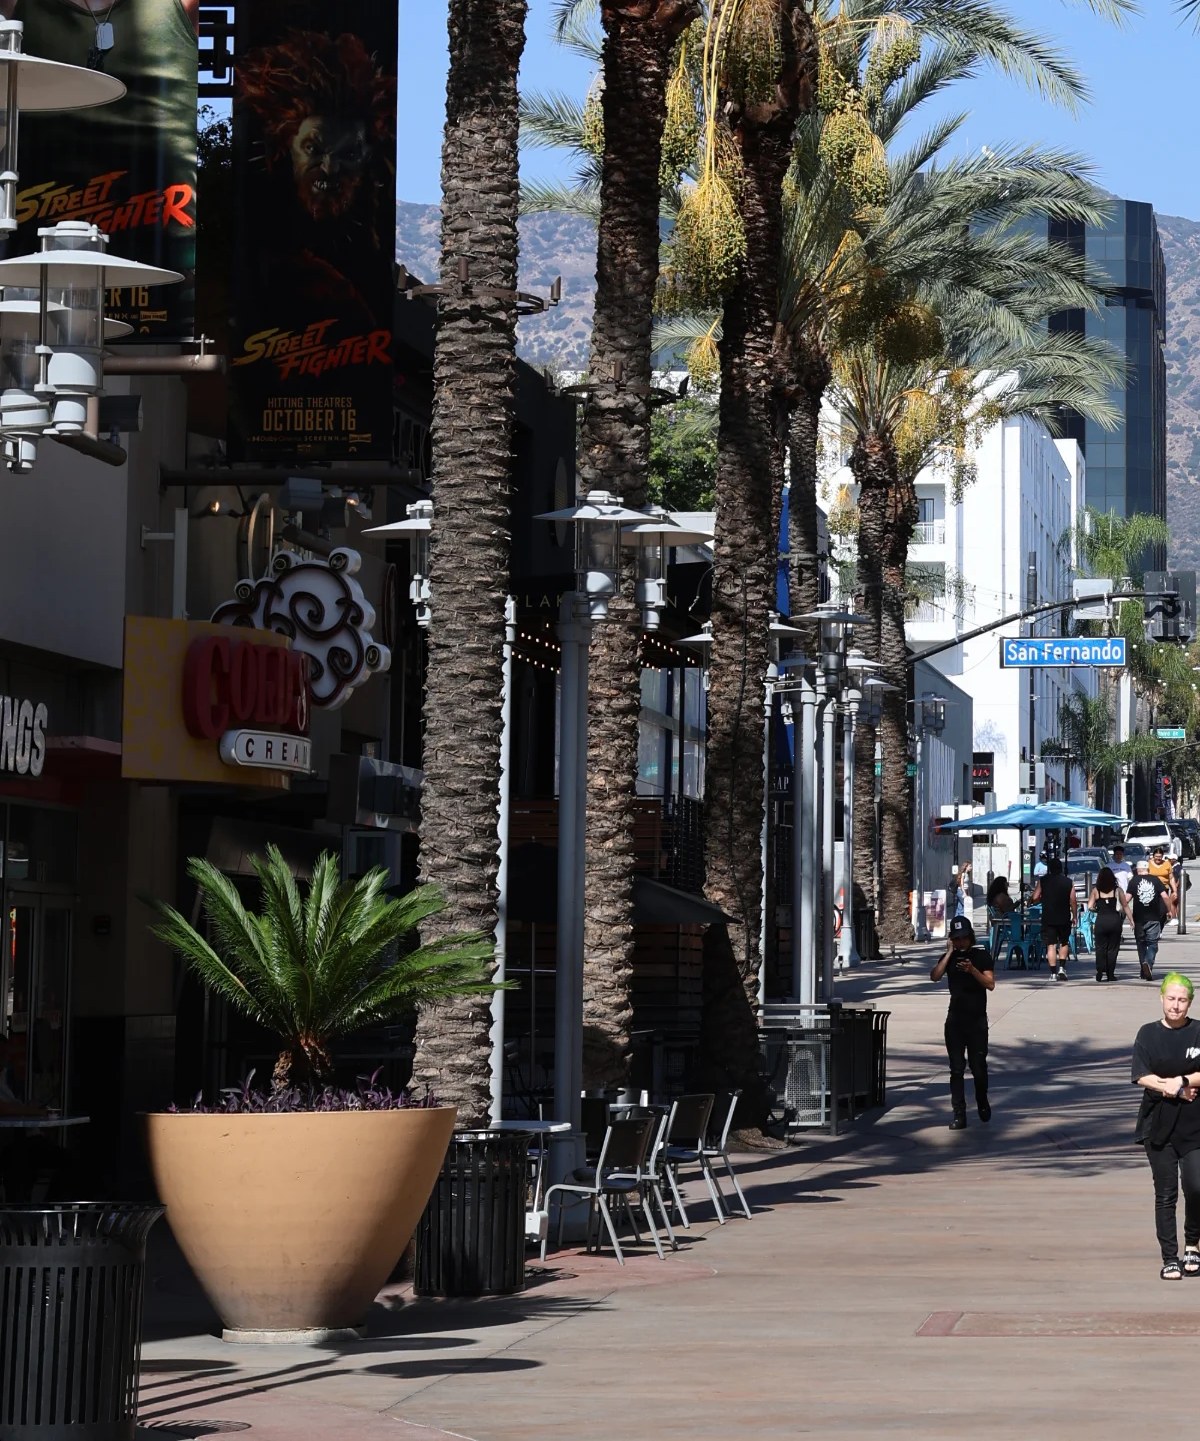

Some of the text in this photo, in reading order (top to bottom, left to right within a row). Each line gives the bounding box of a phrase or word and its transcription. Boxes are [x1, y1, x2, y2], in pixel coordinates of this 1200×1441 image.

[16, 170, 130, 225] STREET
[231, 318, 340, 367] STREET
[273, 329, 393, 382] FIGHTER
[268, 396, 353, 408] HITTING THEATRES
[263, 409, 357, 432] OCTOBER 16
[1007, 640, 1121, 661] San Fernando
